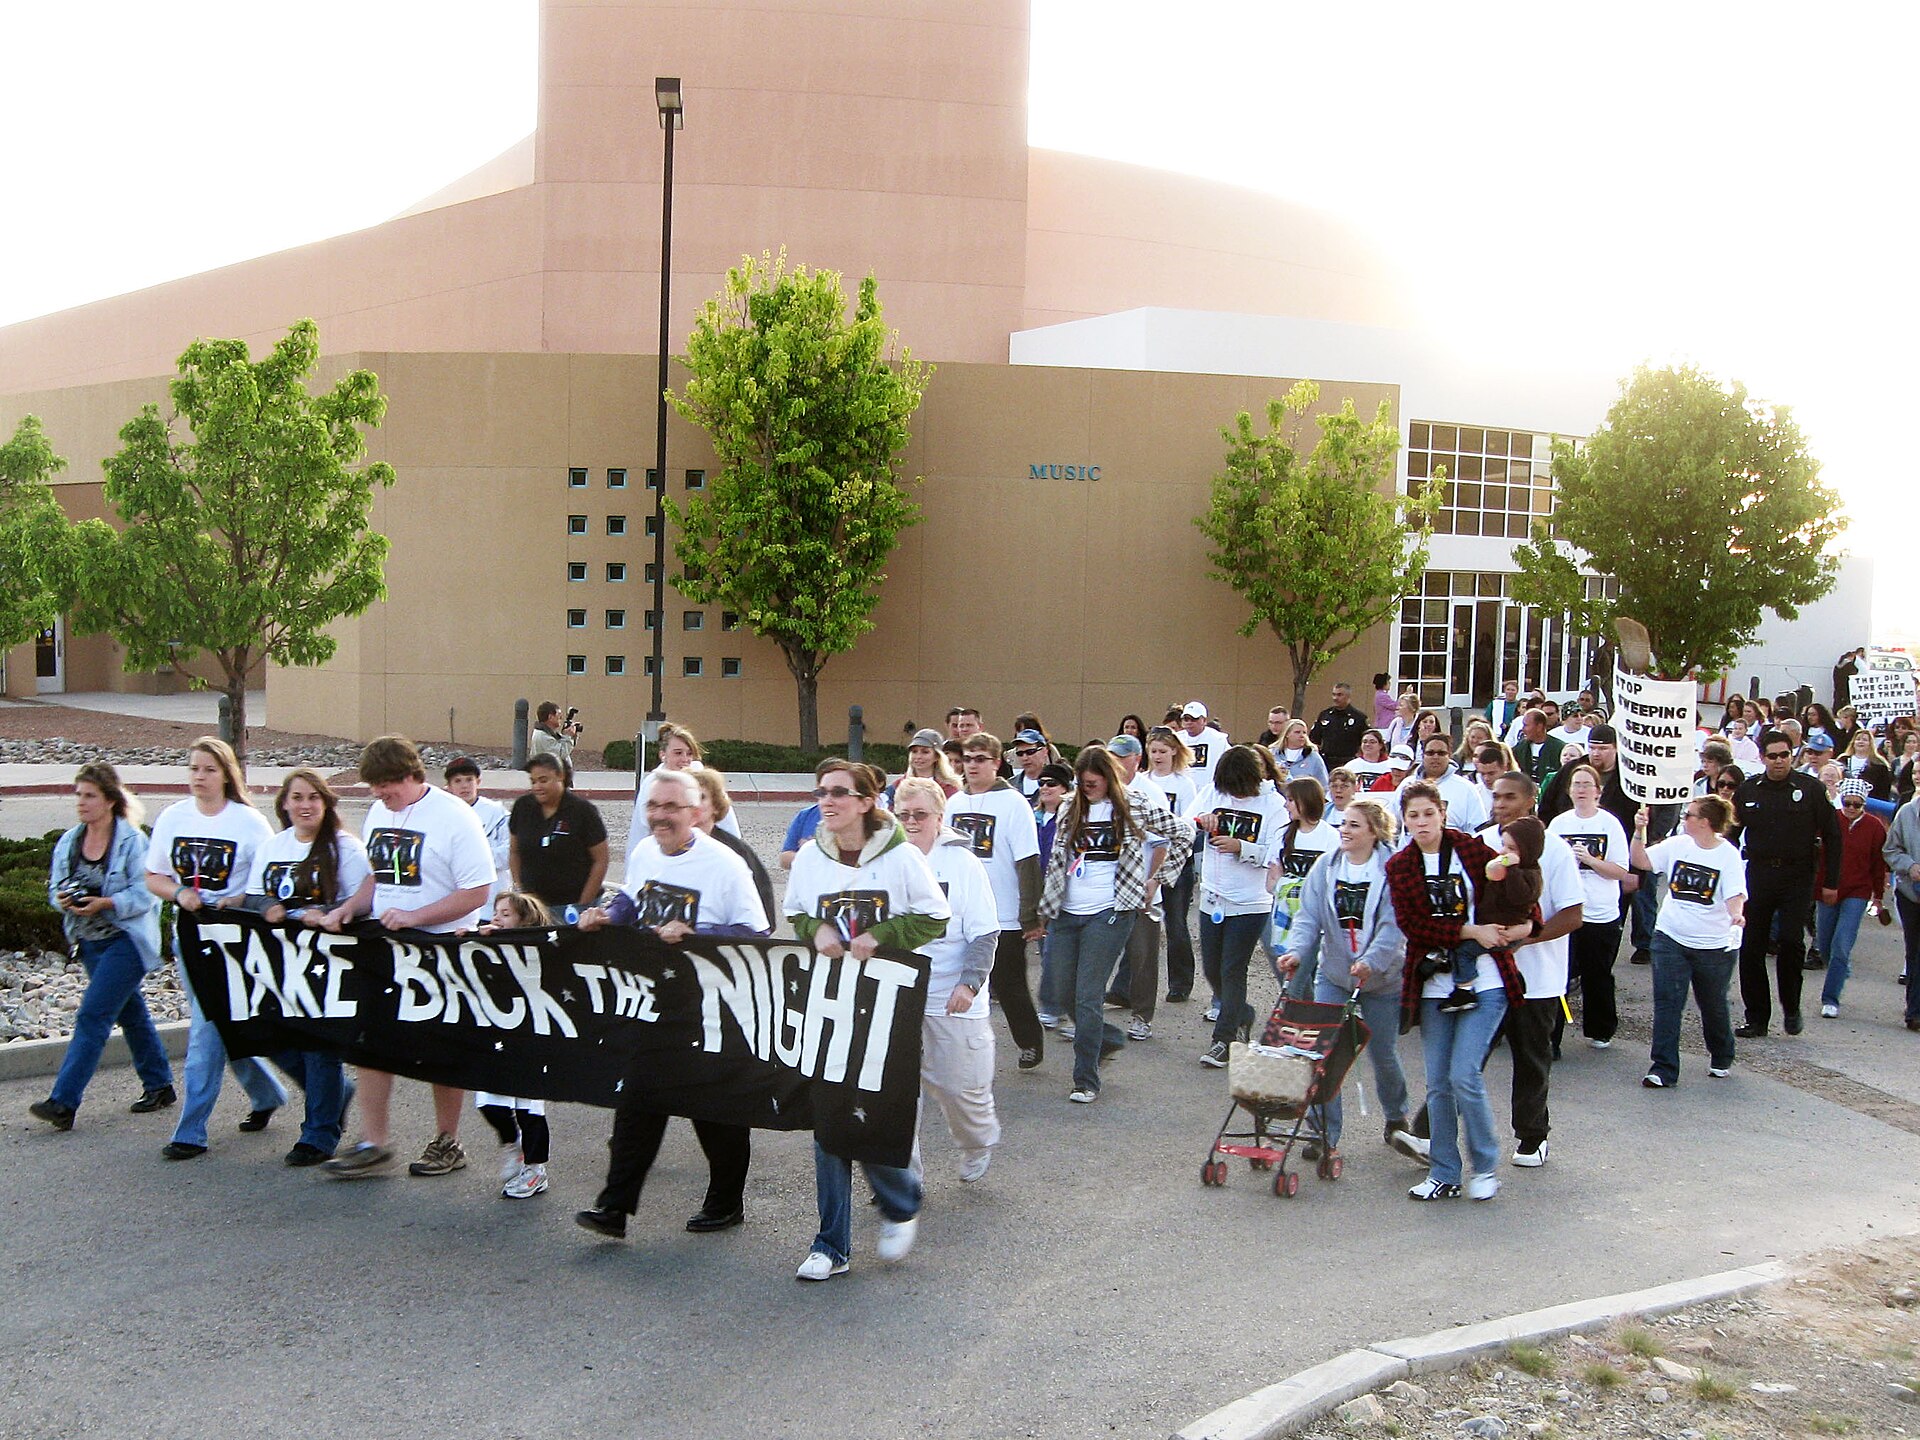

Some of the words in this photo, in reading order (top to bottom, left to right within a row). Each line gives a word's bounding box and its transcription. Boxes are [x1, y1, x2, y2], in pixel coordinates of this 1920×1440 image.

[1028, 463, 1102, 481] MUSIC
[1625, 718, 1682, 739] SEXUAL
[1618, 731, 1676, 758] OLENCE
[1624, 777, 1647, 798] THE
[1655, 787, 1689, 799] RUG
[197, 923, 359, 1022] TAKE
[384, 936, 578, 1039] BACK
[573, 962, 661, 1023] THE
[683, 944, 920, 1092] NIGHT
